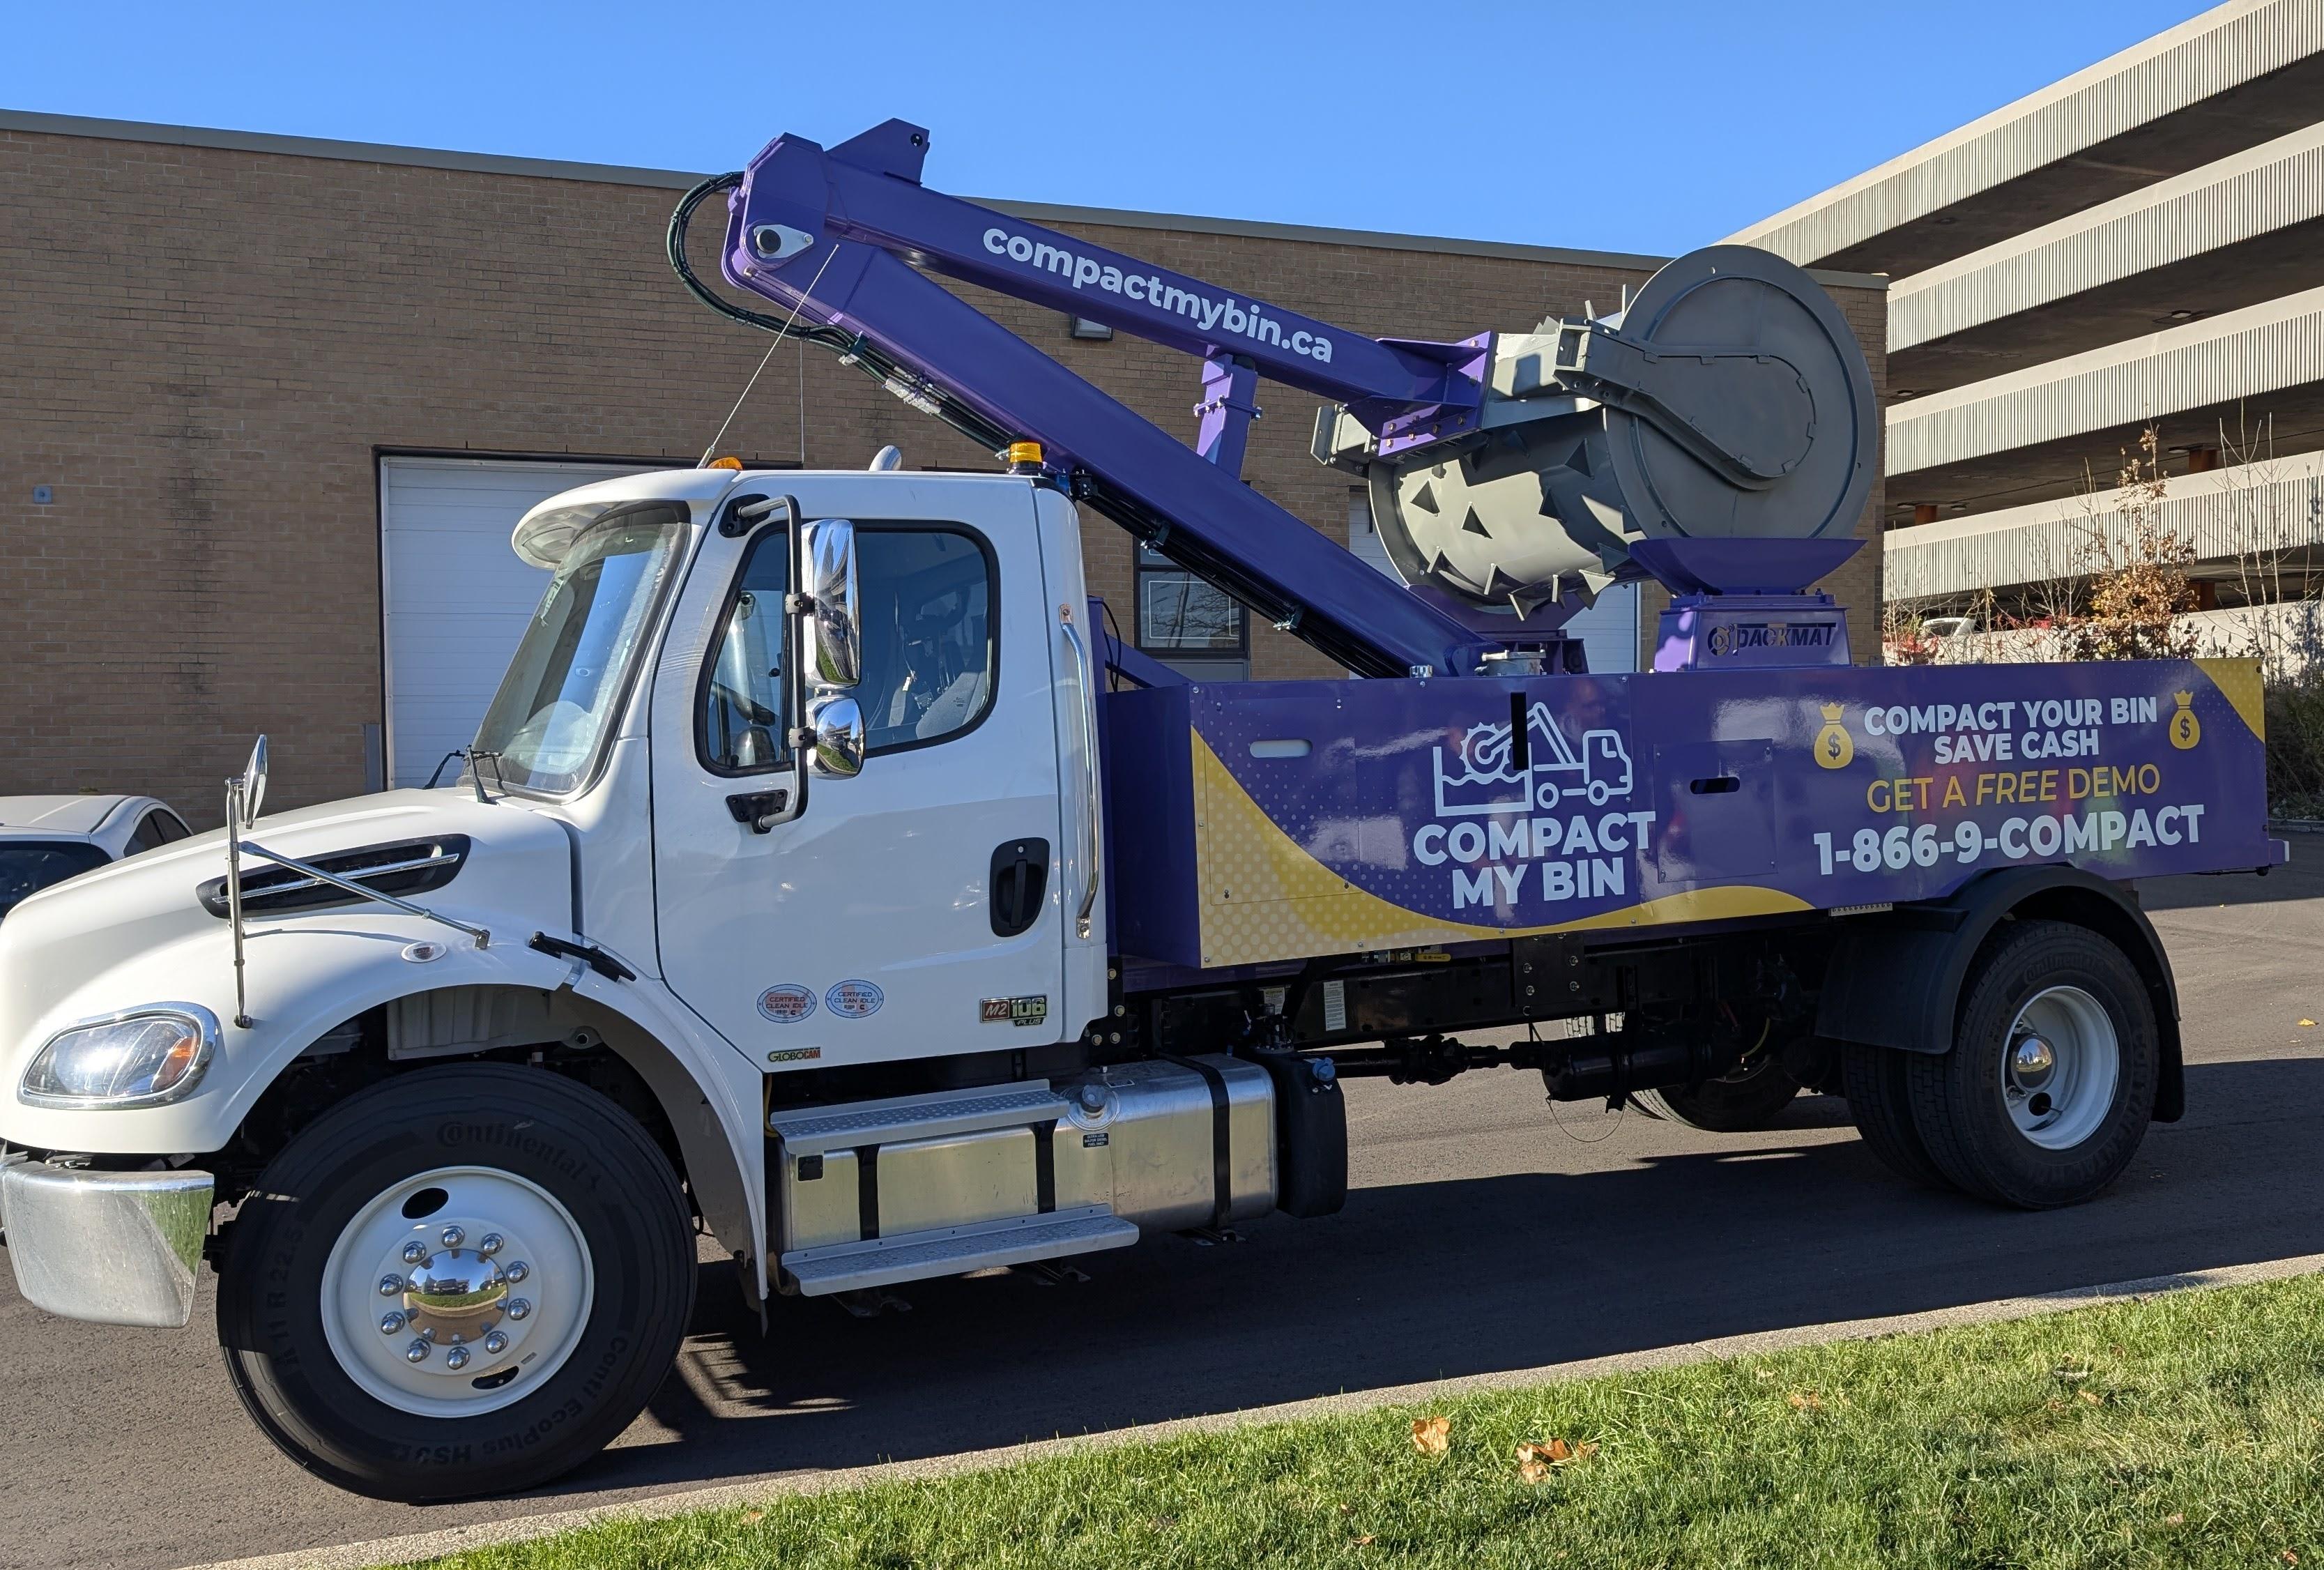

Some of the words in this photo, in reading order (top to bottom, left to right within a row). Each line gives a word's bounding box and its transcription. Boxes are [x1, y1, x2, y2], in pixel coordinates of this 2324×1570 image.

[983, 228, 1333, 363] compactmybin.ca
[1864, 701, 2015, 736] COMPACT
[2021, 698, 2103, 729] YOUR
[2111, 696, 2157, 724] BIN
[2179, 716, 2192, 742] $
[1827, 733, 1842, 761] $
[1934, 733, 2012, 765] SAVE
[2021, 729, 2100, 759] CASH
[1867, 777, 1934, 813] GET
[1942, 776, 1966, 809] A
[1975, 769, 2059, 806] FREE
[2068, 763, 2160, 799] DEMO
[1414, 811, 1656, 865] COMPACT
[1813, 804, 2204, 876] 1-866-9-COMPACT
[1453, 864, 1527, 909] MY
[1543, 857, 1625, 901] BIN
[985, 1003, 1007, 1016] M2
[1011, 997, 1045, 1016] 106
[768, 1048, 820, 1062] GLOBOCAM
[436, 1121, 588, 1180] Continental
[582, 1334, 629, 1398] Conti
[482, 1397, 584, 1454] EcoPlus
